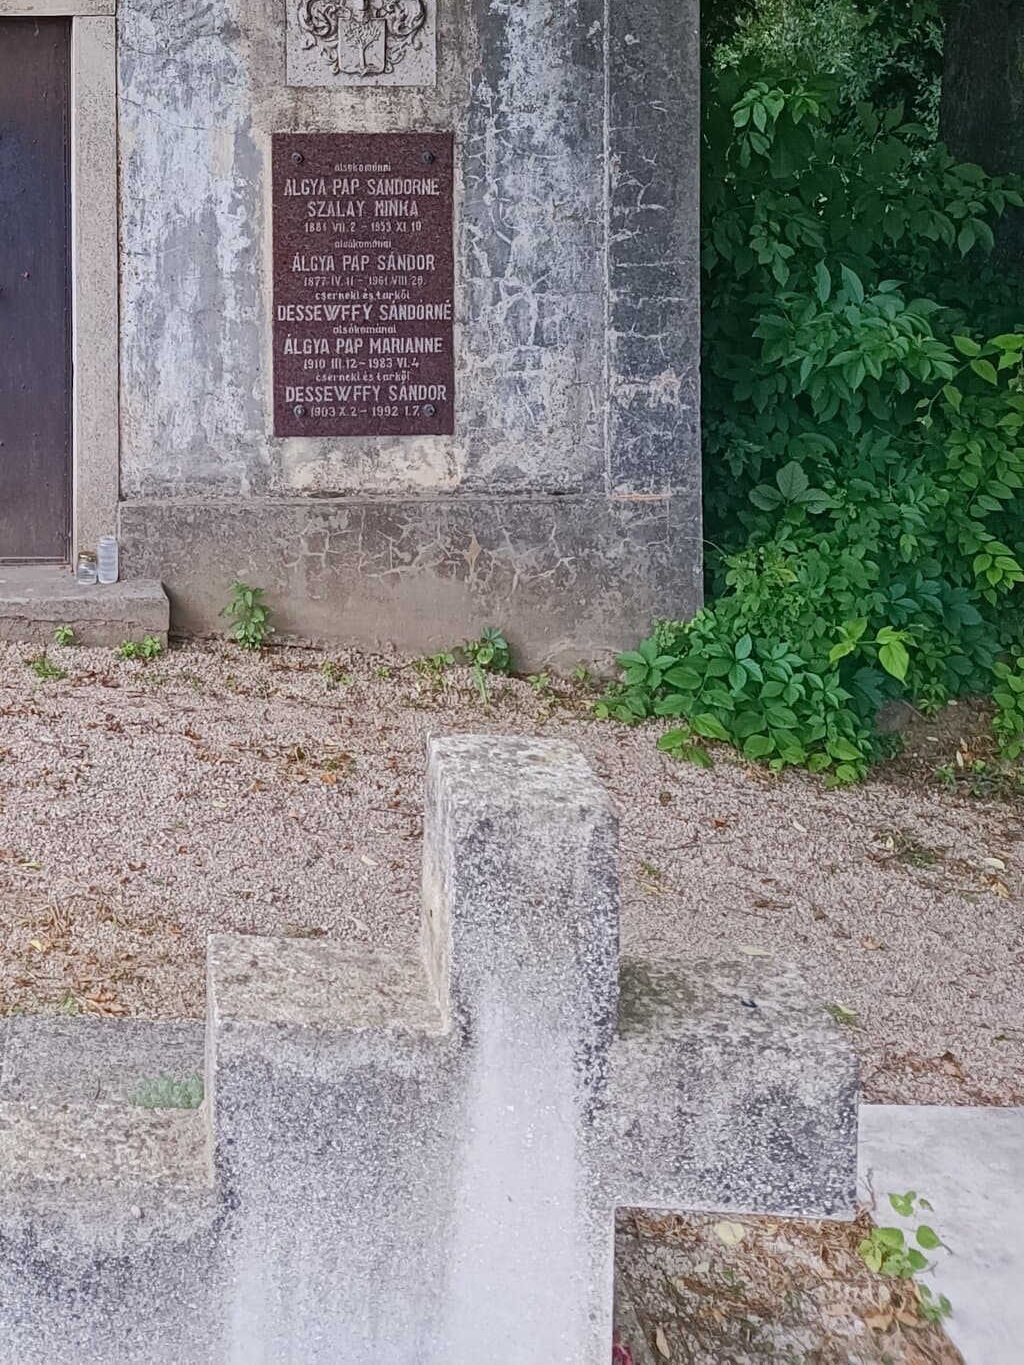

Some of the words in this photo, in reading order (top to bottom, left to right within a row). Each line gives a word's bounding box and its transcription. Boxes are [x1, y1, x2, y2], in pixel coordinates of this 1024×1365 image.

[333, 179, 359, 195] PAP
[308, 201, 365, 217] SZALAY
[375, 201, 418, 217] MINKA
[371, 222, 391, 232] 1953
[292, 252, 335, 272] ÁLGYA
[343, 255, 369, 271] PAP
[377, 252, 435, 271] SÁNDOR
[315, 290, 359, 300] cserneki
[278, 304, 372, 321] DESSEWFFY
[284, 333, 330, 355] ÁLGYA
[336, 338, 363, 354] PAP
[370, 337, 443, 354] MARIANNE
[304, 359, 325, 370] 1910
[369, 358, 392, 368] 1983
[316, 372, 360, 382] cserneki
[286, 385, 380, 402] DESSEWFFY
[389, 383, 447, 400] SÁNDOR
[311, 407, 335, 417] 1903
[372, 407, 398, 416] 1992
